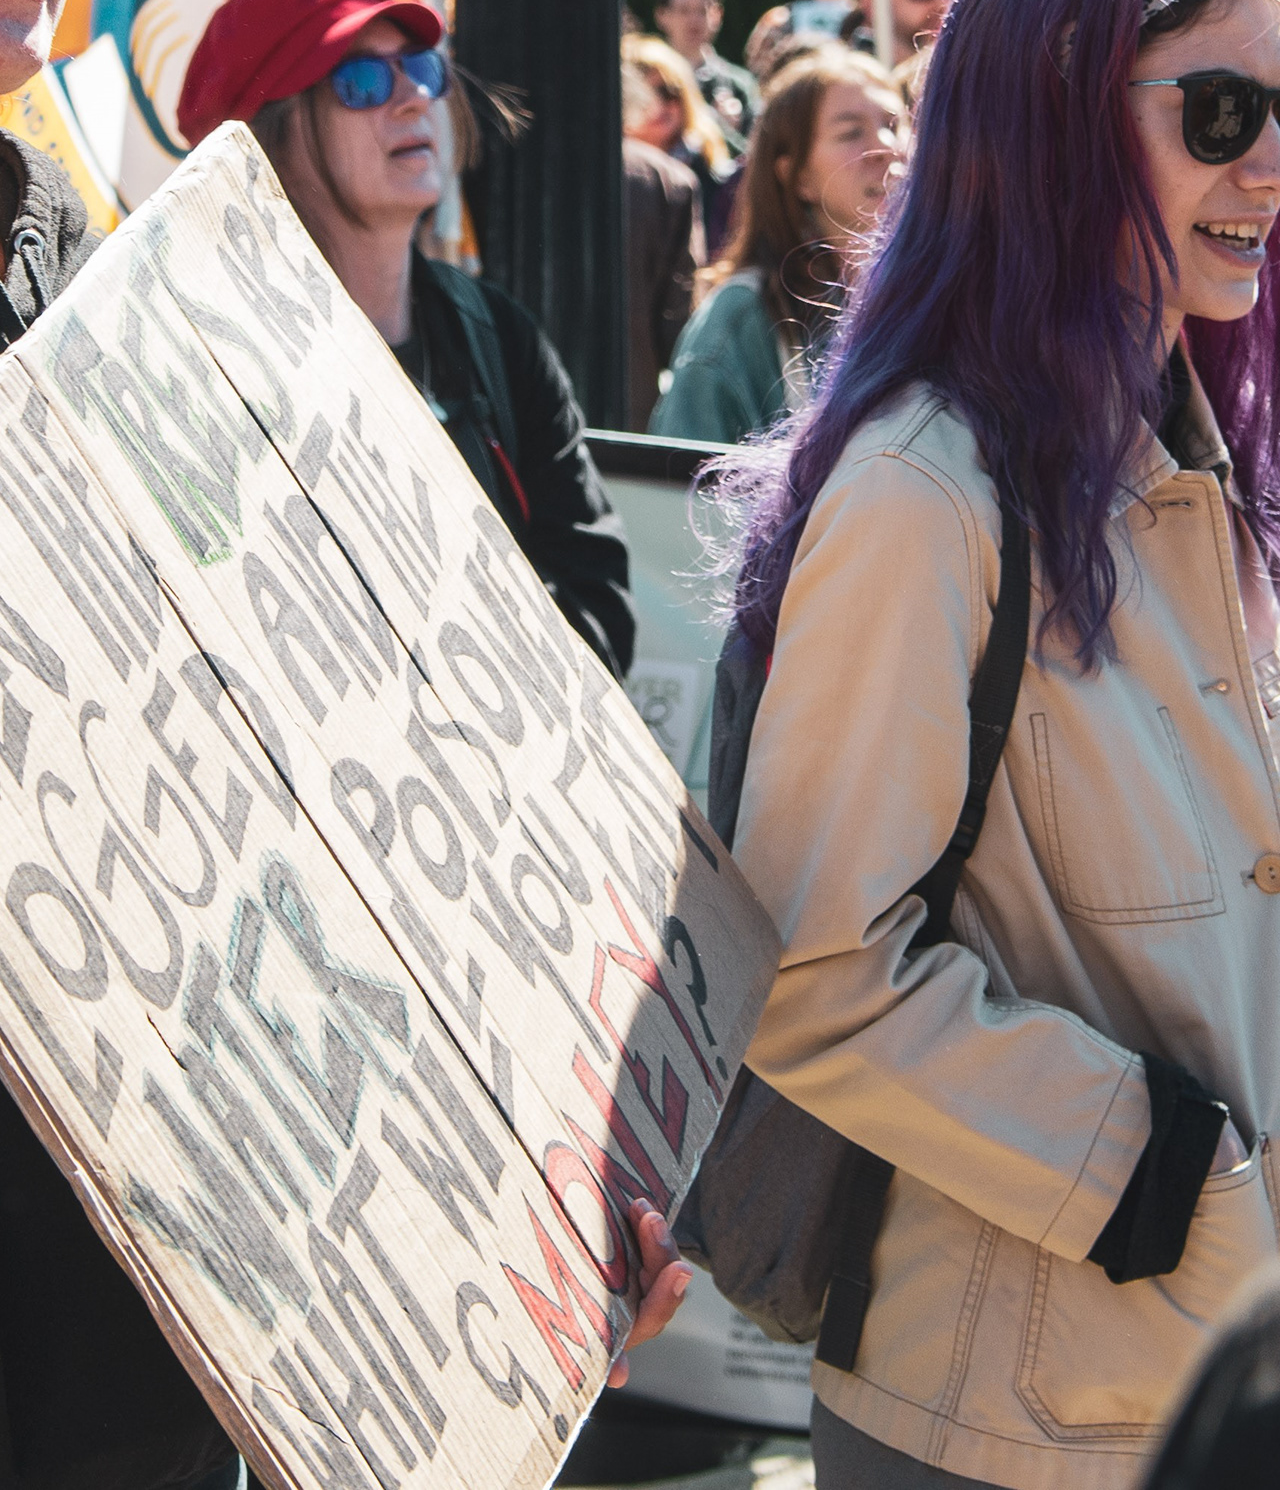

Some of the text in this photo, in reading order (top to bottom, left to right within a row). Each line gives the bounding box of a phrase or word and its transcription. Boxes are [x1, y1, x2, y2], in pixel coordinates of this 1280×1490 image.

[51, 212, 297, 567] TREES
[216, 153, 334, 369] ARE
[293, 389, 443, 623] THE
[241, 494, 400, 728] AND
[125, 504, 584, 1335] WATER POISONED
[251, 1141, 452, 1490] WHAT
[470, 791, 613, 1064] YOU
